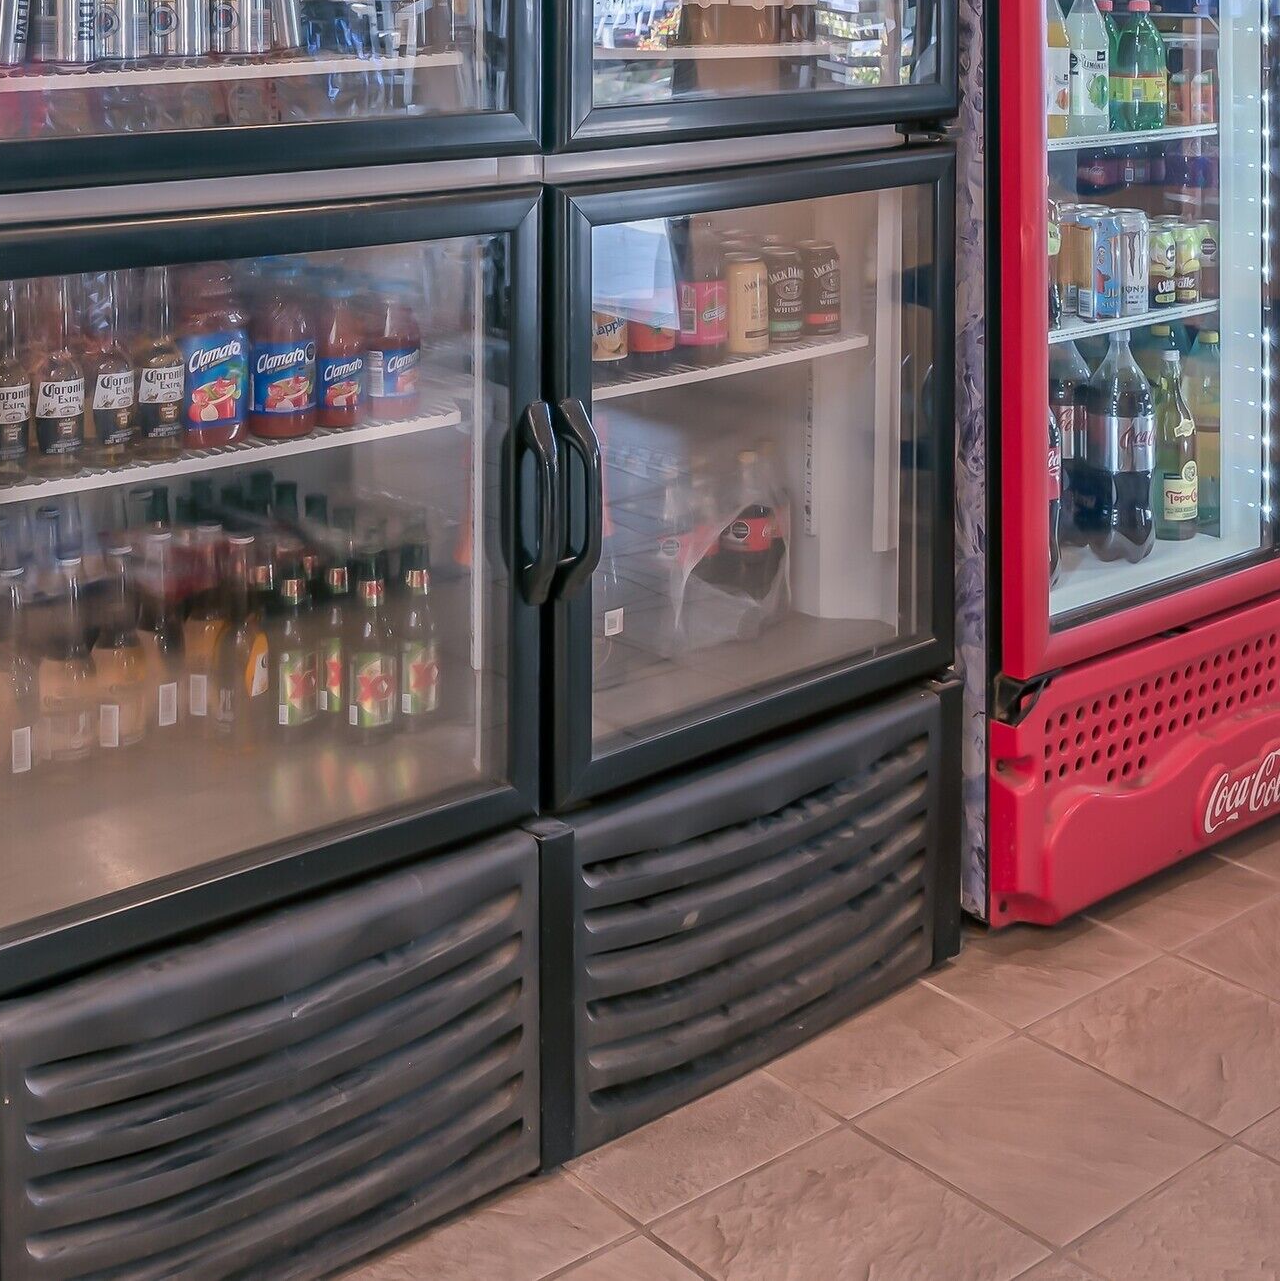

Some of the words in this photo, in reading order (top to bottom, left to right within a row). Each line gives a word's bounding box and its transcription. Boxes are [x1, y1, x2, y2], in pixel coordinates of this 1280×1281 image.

[1177, 277, 1196, 288] alle
[597, 317, 625, 337] apple
[188, 339, 242, 373] Clamato
[256, 347, 305, 374] Clamato
[323, 358, 363, 382] Clamato
[100, 375, 134, 390] Coron
[159, 381, 181, 390] Extra
[2, 402, 25, 410] Extra
[57, 395, 81, 404] Extra
